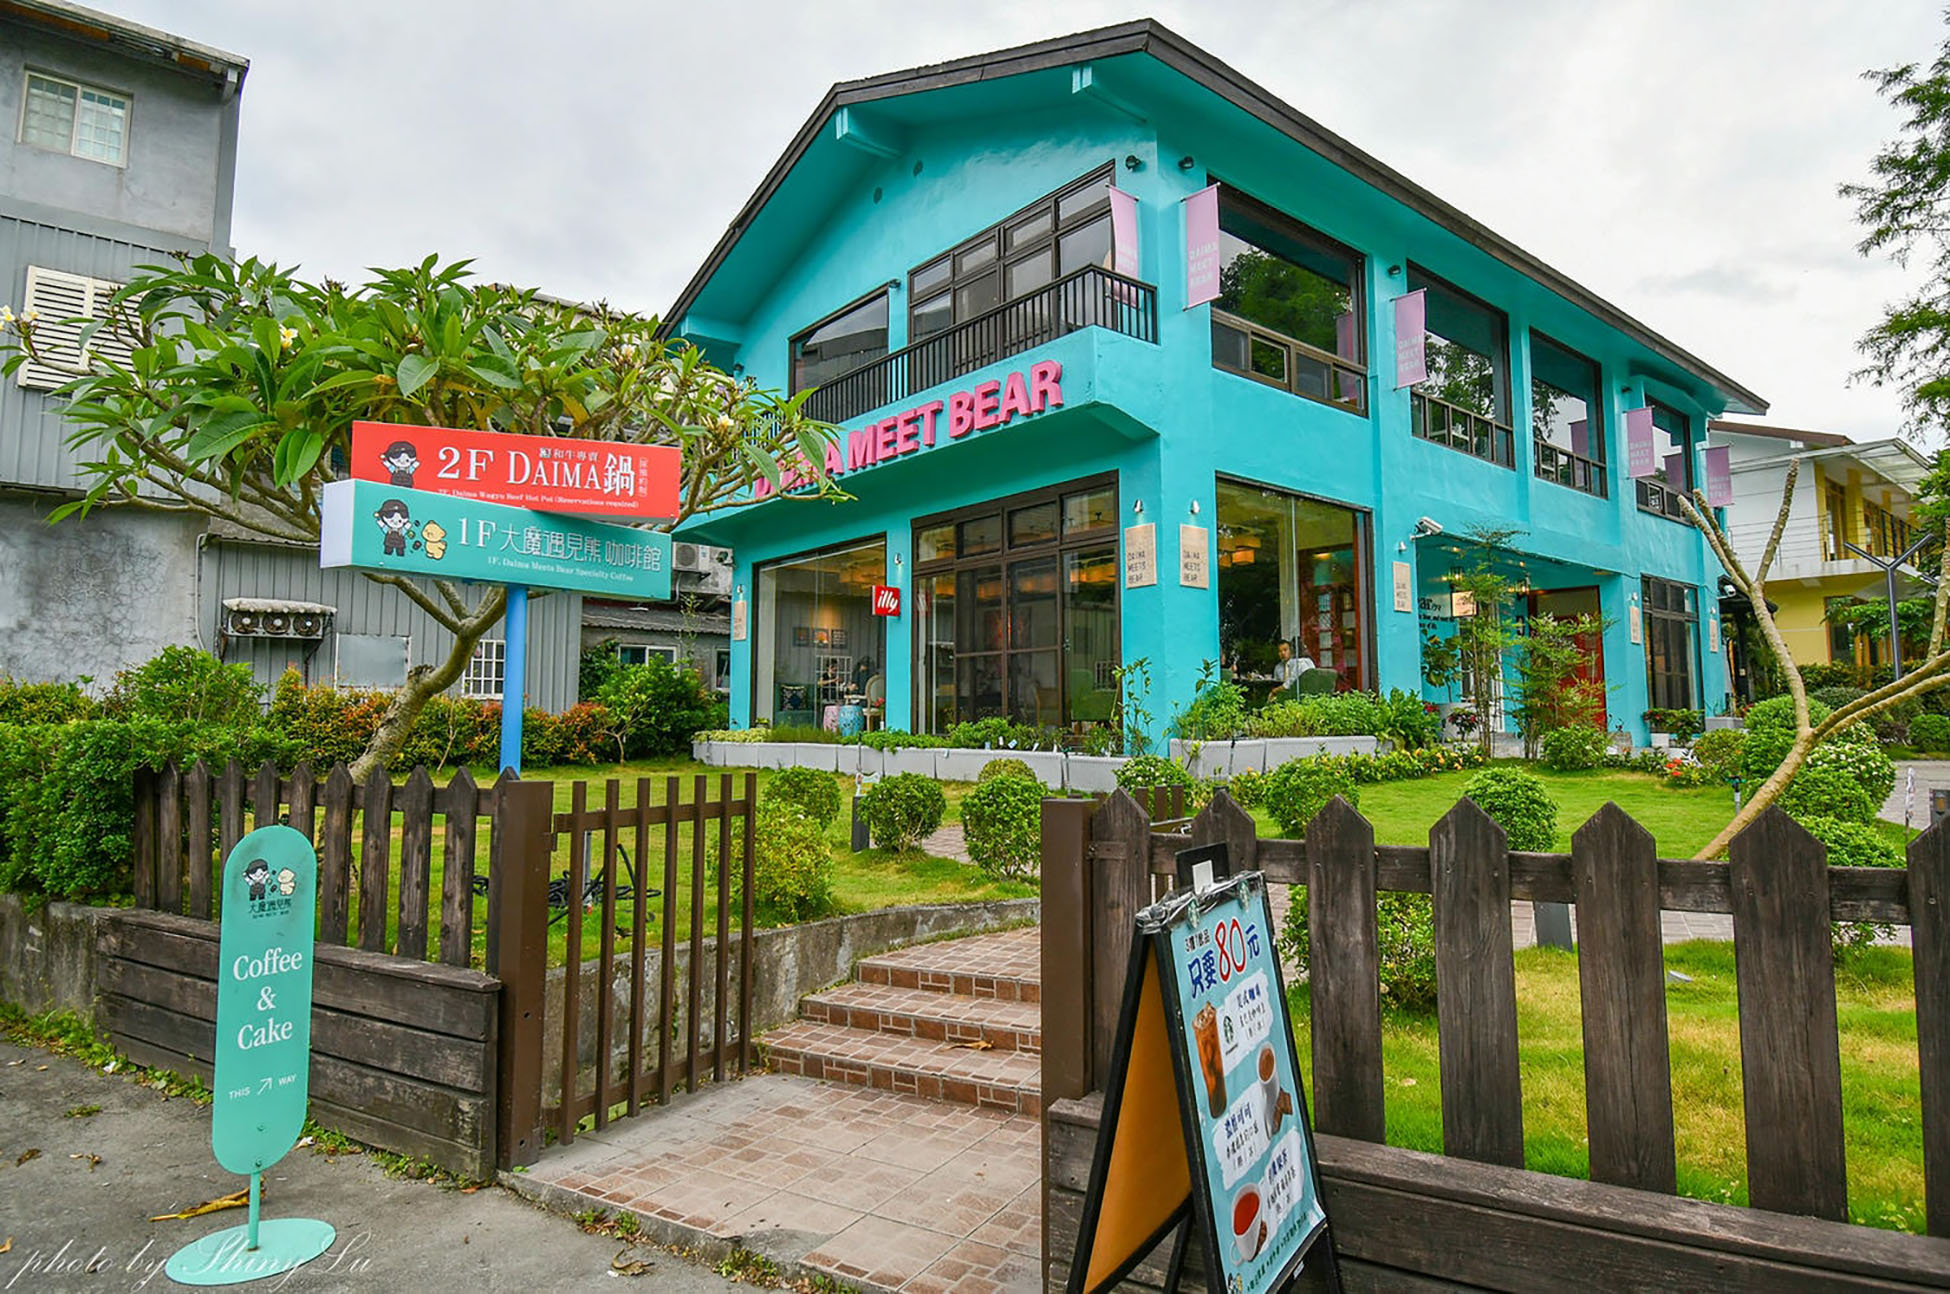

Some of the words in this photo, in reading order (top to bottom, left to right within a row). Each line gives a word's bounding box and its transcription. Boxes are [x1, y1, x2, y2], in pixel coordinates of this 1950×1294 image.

[848, 400, 944, 472] MEET
[949, 359, 1064, 439] BEAR
[437, 446, 494, 481] 2F
[506, 493, 523, 501] Beef
[526, 494, 539, 502] Hot
[503, 558, 530, 569] Daima
[575, 567, 609, 580] Specialty
[610, 571, 633, 582] Coffee
[605, 540, 662, 572] 咖啡館
[877, 590, 898, 613] illy
[233, 947, 302, 981] Coffee
[257, 986, 276, 1011] &
[237, 1017, 293, 1050] Cake
[229, 1086, 251, 1101] THIS
[278, 1073, 297, 1086] WAY
